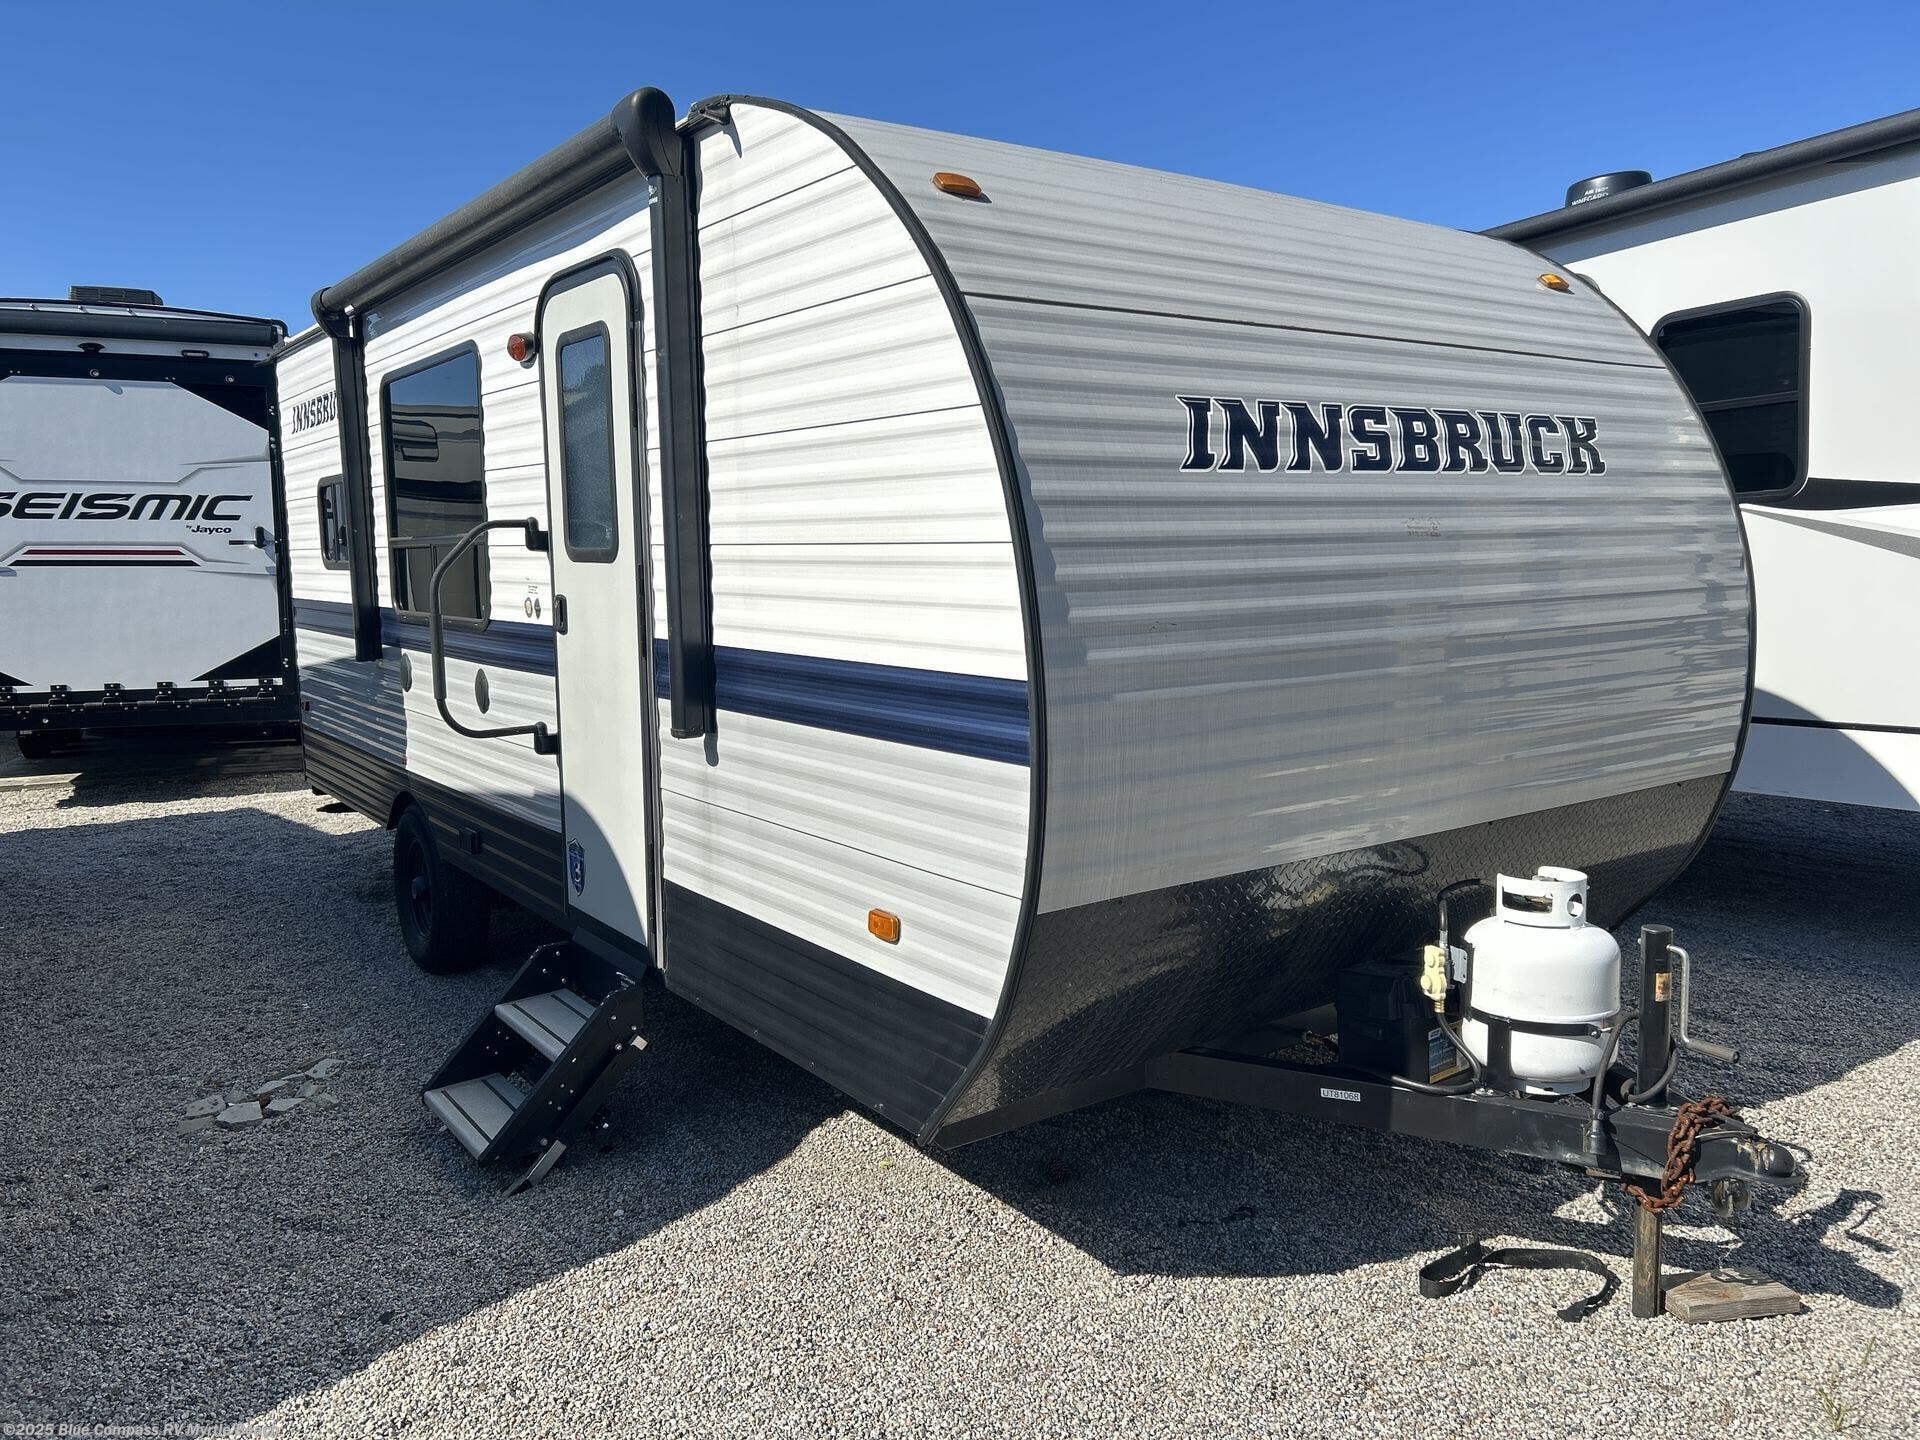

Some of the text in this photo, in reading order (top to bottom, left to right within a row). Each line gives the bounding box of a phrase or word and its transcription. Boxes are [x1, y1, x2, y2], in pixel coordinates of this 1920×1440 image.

[1175, 394, 1607, 476] INNSBRUCK
[191, 524, 232, 535] Jayco
[1322, 1089, 1359, 1101] UT81068
